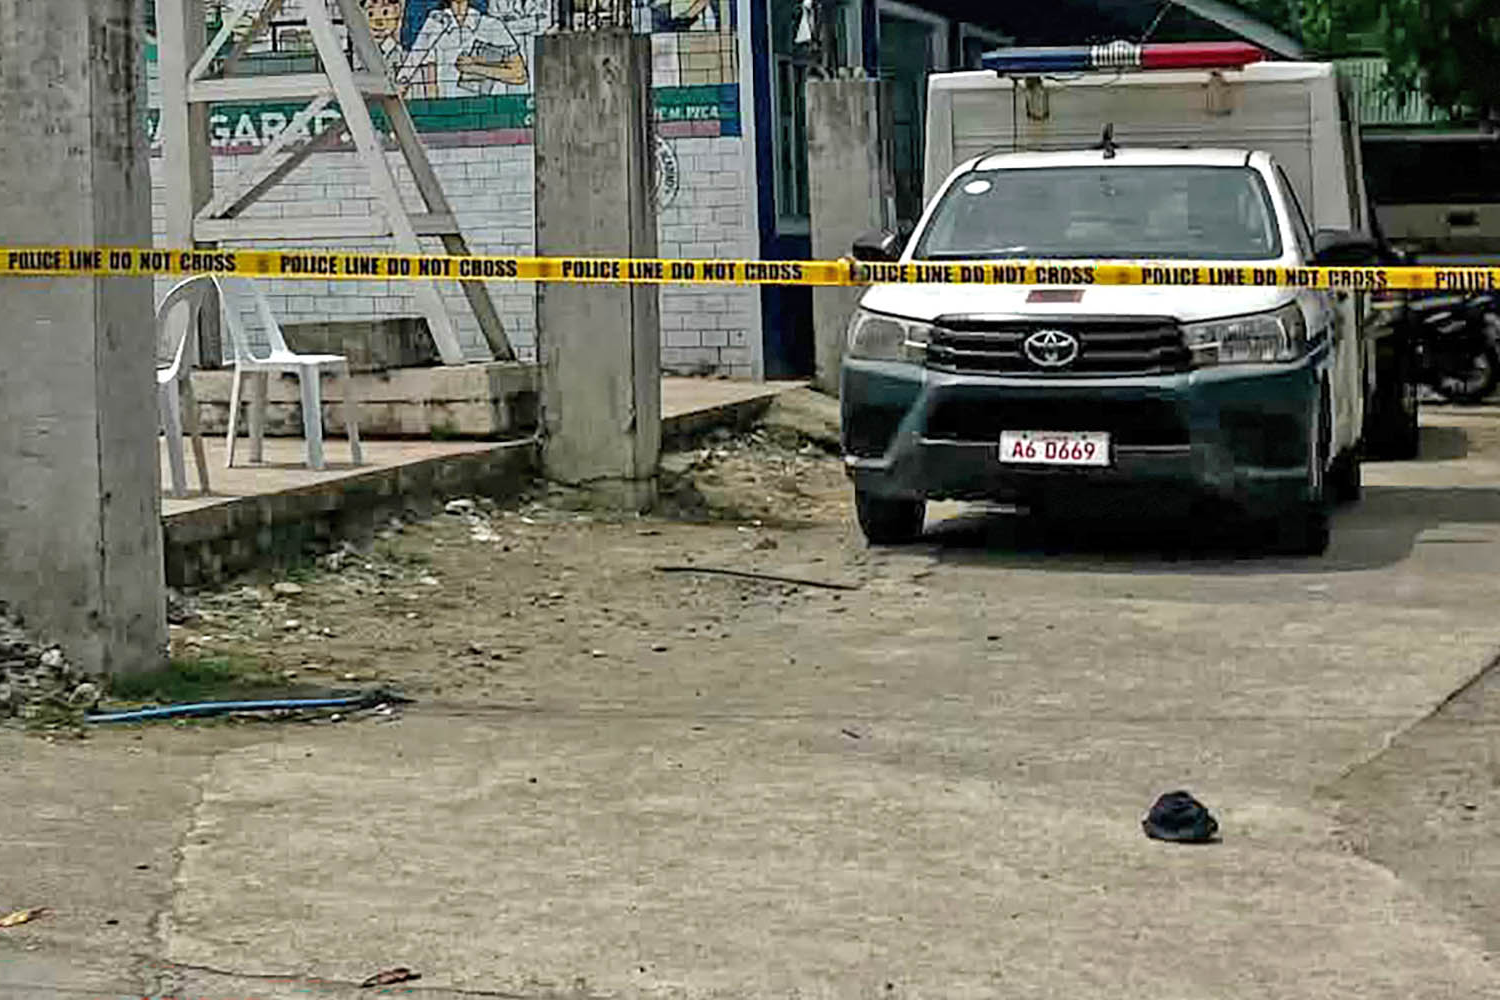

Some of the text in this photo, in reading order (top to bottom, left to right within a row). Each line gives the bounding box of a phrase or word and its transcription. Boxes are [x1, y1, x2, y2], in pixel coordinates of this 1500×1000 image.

[8, 252, 236, 271] POLICE LINE DO NOT CROSS
[280, 255, 517, 277] POLICE LINE DO NOT CROSS
[562, 261, 803, 281] POLICE LINE DO NOT CROSS
[916, 265, 953, 283] LINE
[961, 265, 985, 283] DO
[993, 265, 1026, 283] NOT
[1035, 267, 1095, 284] CROSS
[1141, 267, 1388, 288] POLICE LINE DO NOT CROSS
[1435, 271, 1496, 288] POLICE
[1012, 441, 1095, 460] A6 0669
